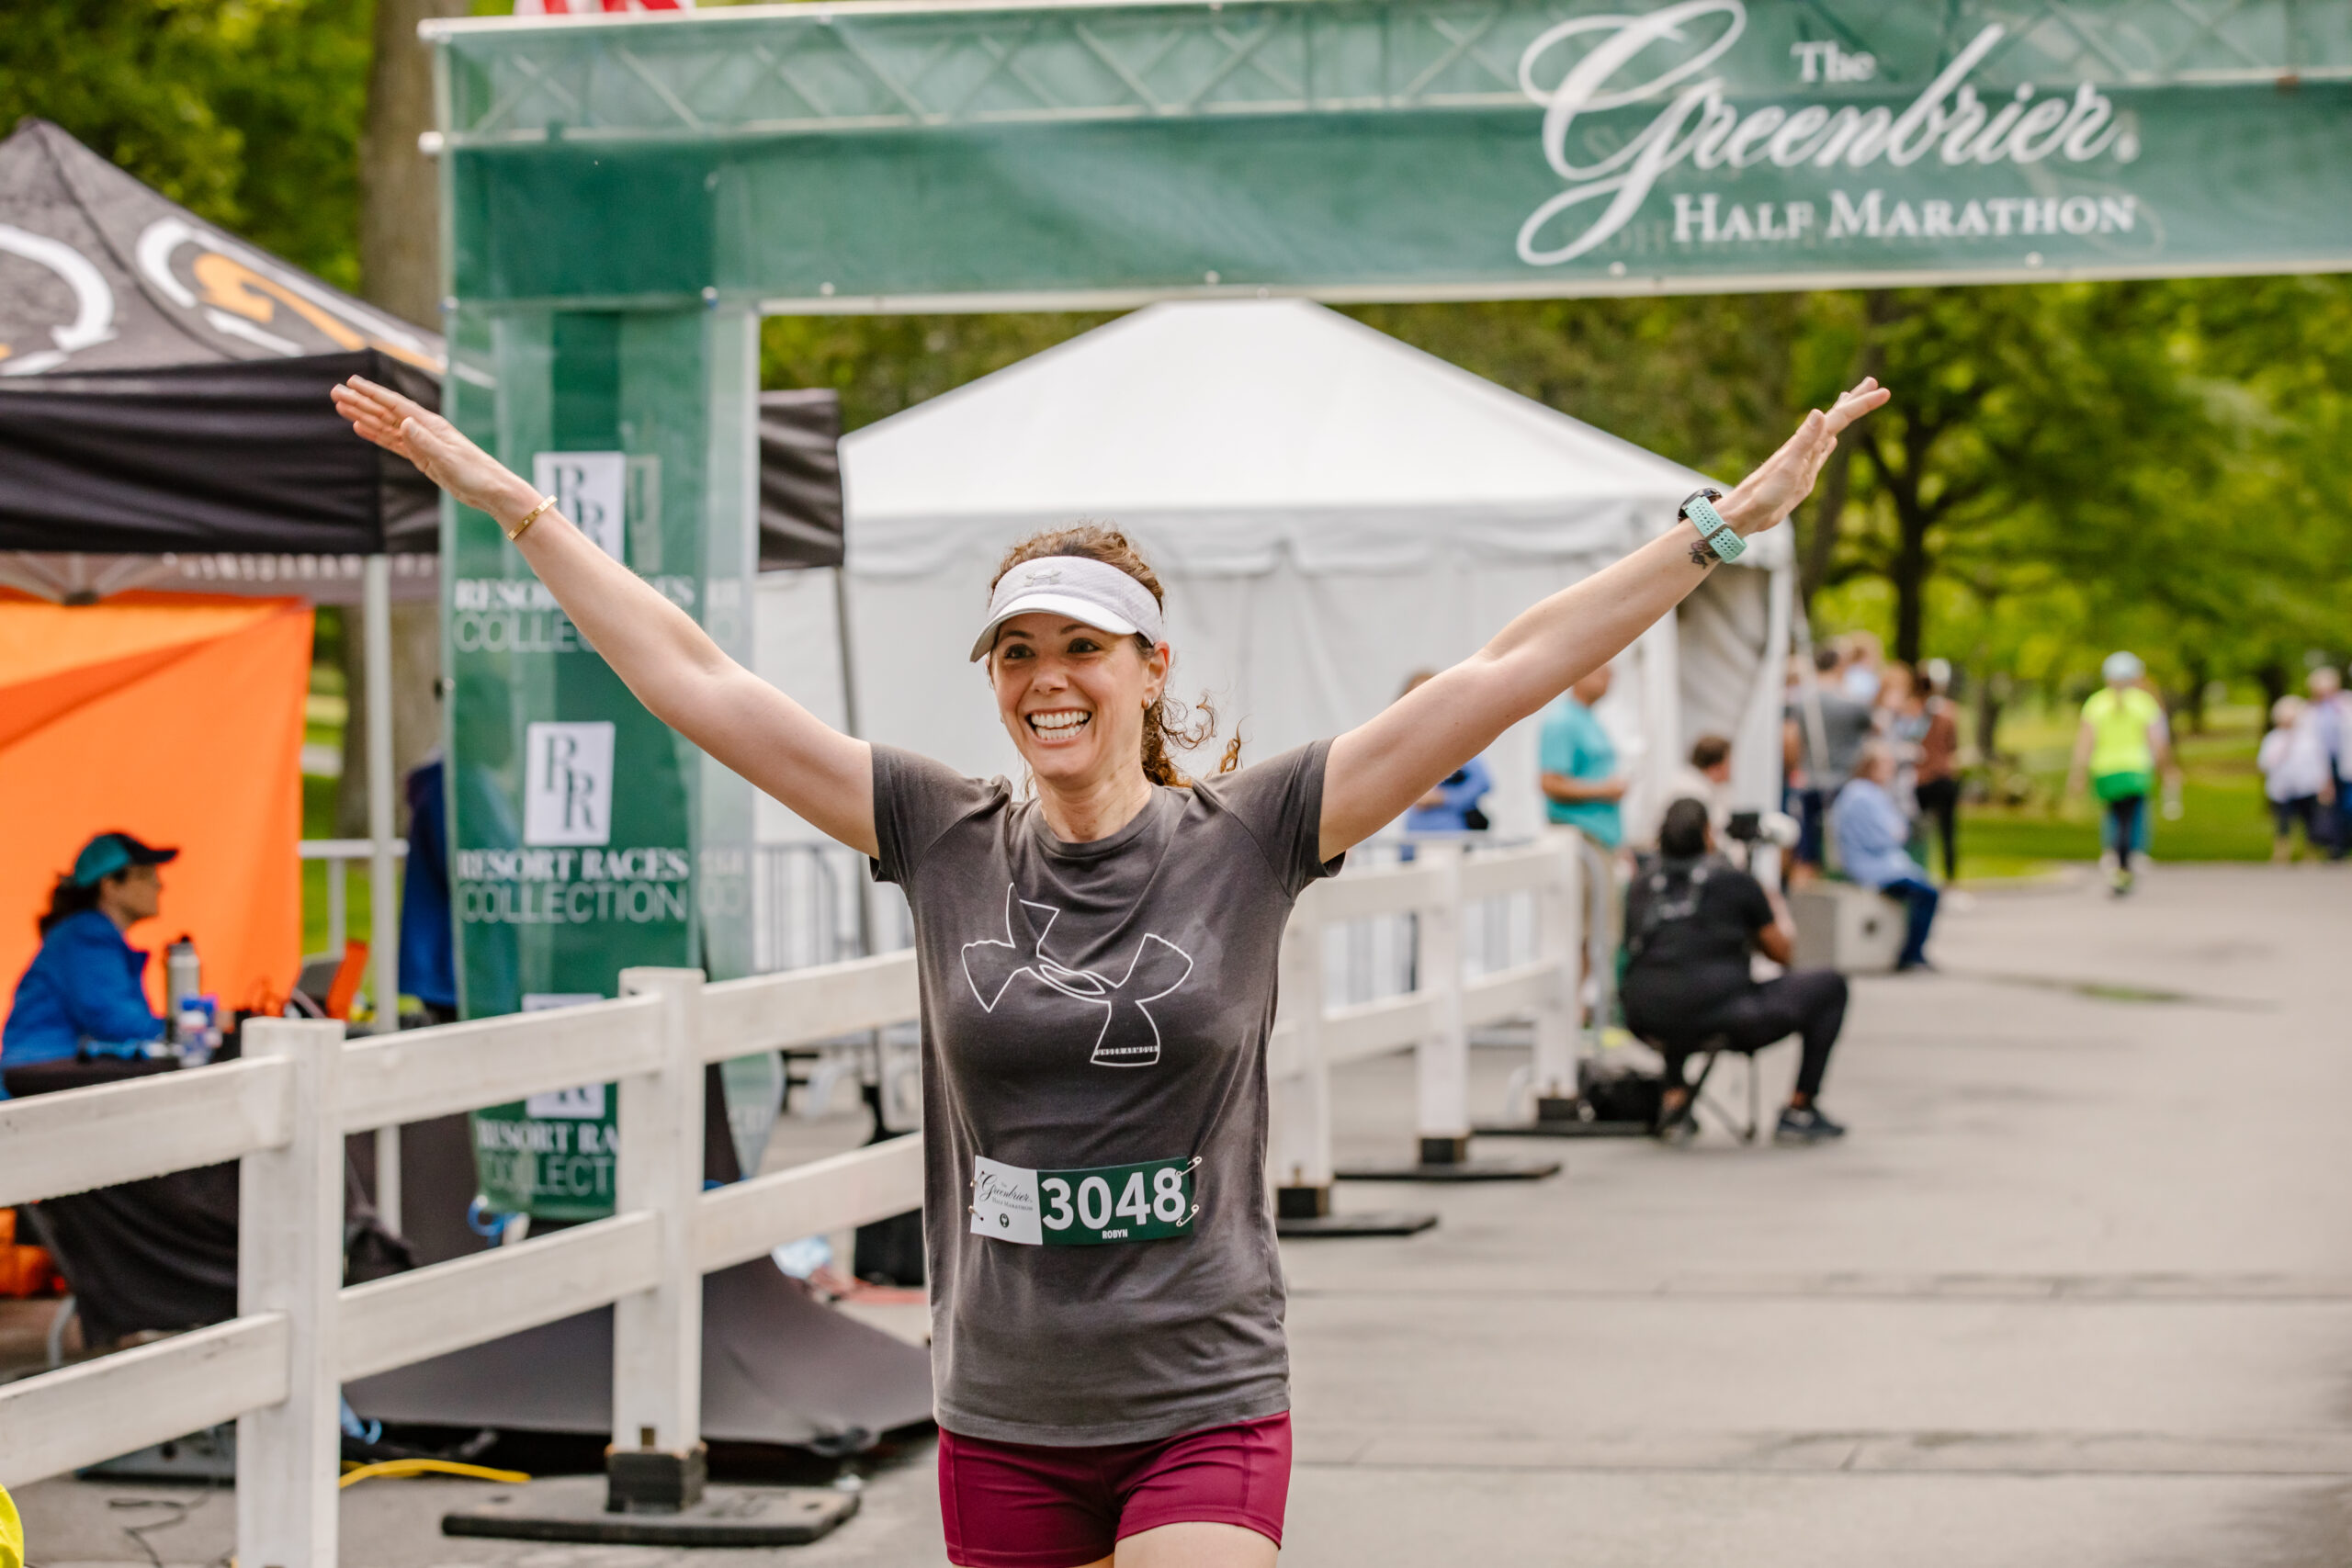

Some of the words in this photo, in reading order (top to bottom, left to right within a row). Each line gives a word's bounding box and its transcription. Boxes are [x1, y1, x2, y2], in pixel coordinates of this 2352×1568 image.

[1791, 39, 1876, 84] The
[1672, 192, 1816, 242] HALF
[1824, 189, 2138, 238] MARATHON
[457, 848, 578, 882] RESORT
[581, 847, 690, 882] RACES
[458, 882, 689, 924] COLLECTION
[1041, 1168, 1186, 1230] 3048
[1102, 1228, 1128, 1240] ROBYN
